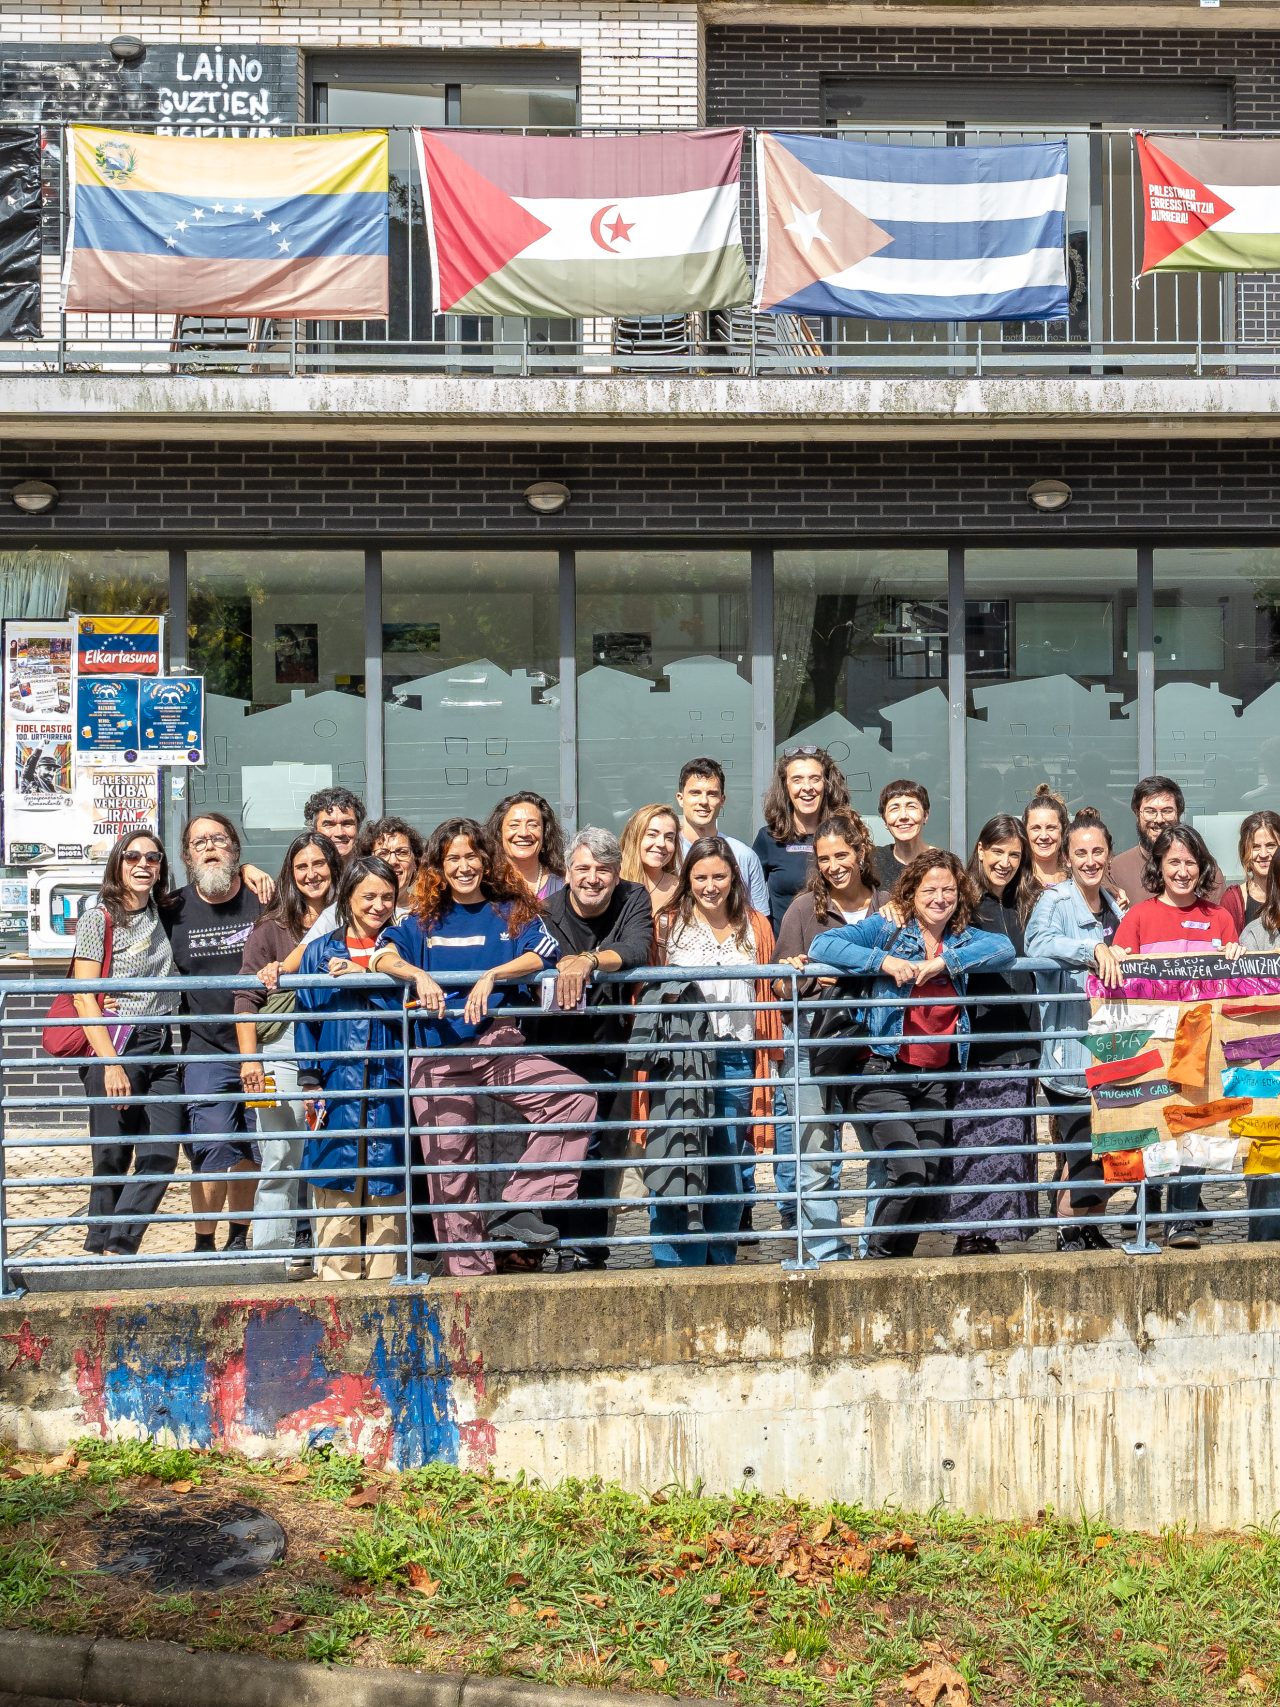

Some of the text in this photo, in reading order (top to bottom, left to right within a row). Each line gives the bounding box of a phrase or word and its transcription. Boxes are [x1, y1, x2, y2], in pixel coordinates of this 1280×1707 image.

[1149, 184, 1196, 201] PALESTINAR
[1150, 196, 1215, 215] ERRESISTENTZIA
[1151, 210, 1189, 224] AURRERA!
[85, 649, 157, 665] Elkartasuna
[16, 725, 72, 733] FIDEL CASTRO
[93, 775, 155, 785] PALESTINA
[104, 784, 147, 798] KUBA
[94, 798, 154, 809] VENEZUELA
[93, 824, 118, 834] ZURE
